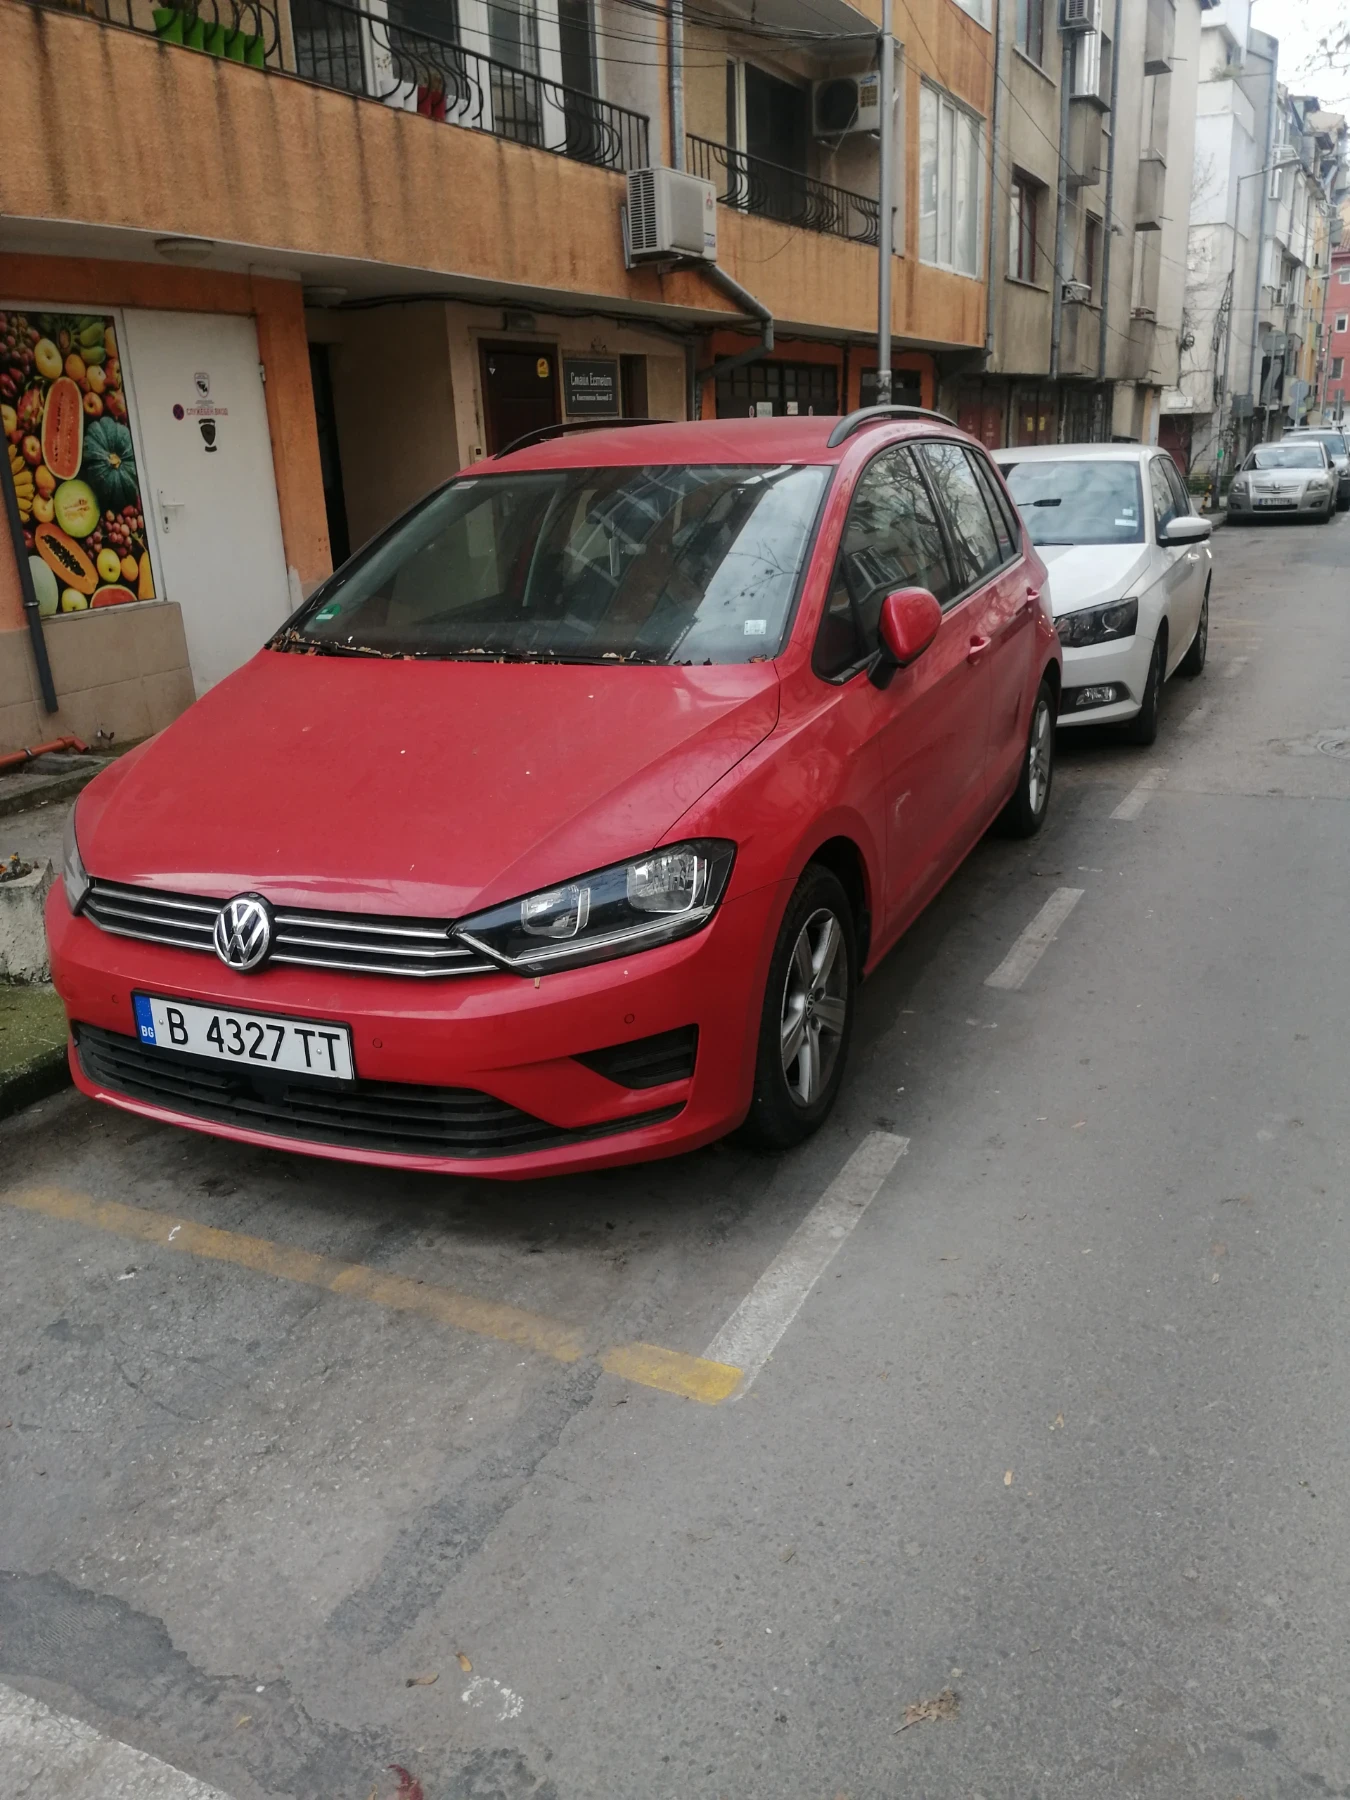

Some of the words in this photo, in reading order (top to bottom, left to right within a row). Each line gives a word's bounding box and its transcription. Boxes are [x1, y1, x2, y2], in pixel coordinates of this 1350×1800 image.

[214, 900, 270, 969] VW
[141, 1025, 155, 1039] BG
[166, 1007, 189, 1045] B
[206, 1016, 285, 1062] 4327
[294, 1028, 341, 1072] TT
